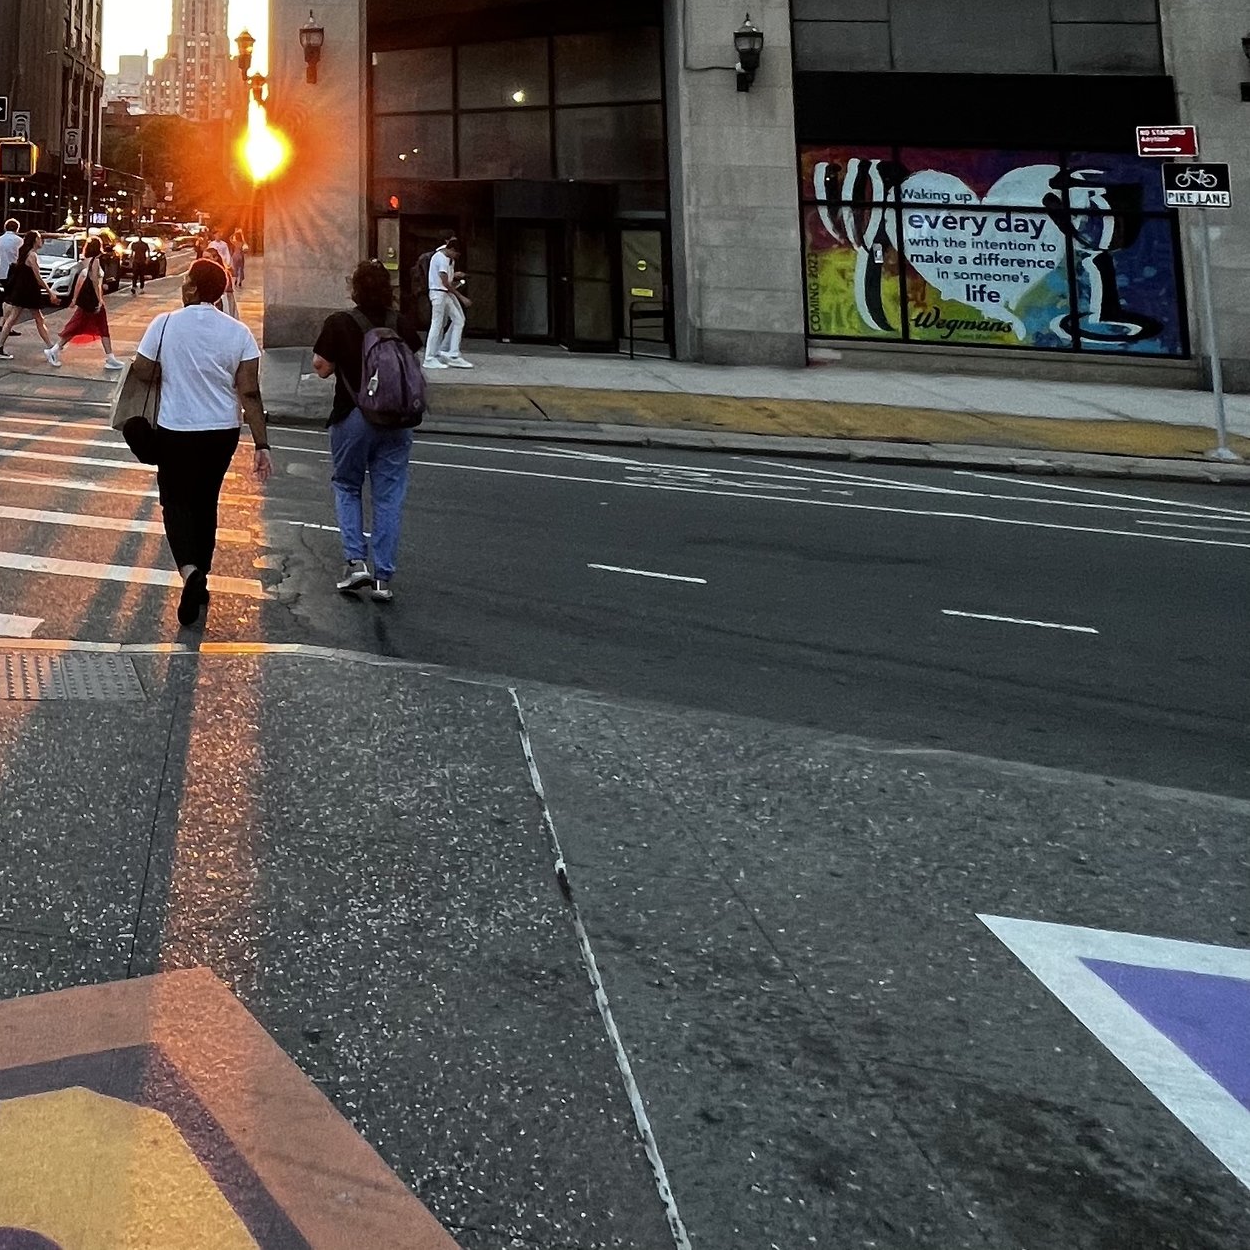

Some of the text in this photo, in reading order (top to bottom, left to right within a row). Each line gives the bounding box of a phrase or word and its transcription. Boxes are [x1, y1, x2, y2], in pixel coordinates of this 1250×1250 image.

[902, 188, 972, 205] Waking up
[1198, 192, 1228, 205] LANE
[908, 211, 1047, 240] every day
[908, 236, 1057, 253] with the intention to
[910, 251, 1055, 269] make a difference
[937, 268, 1030, 283] in someone's
[965, 283, 1001, 303] life
[808, 283, 822, 332] COMING
[911, 306, 1013, 339] Wegmans
